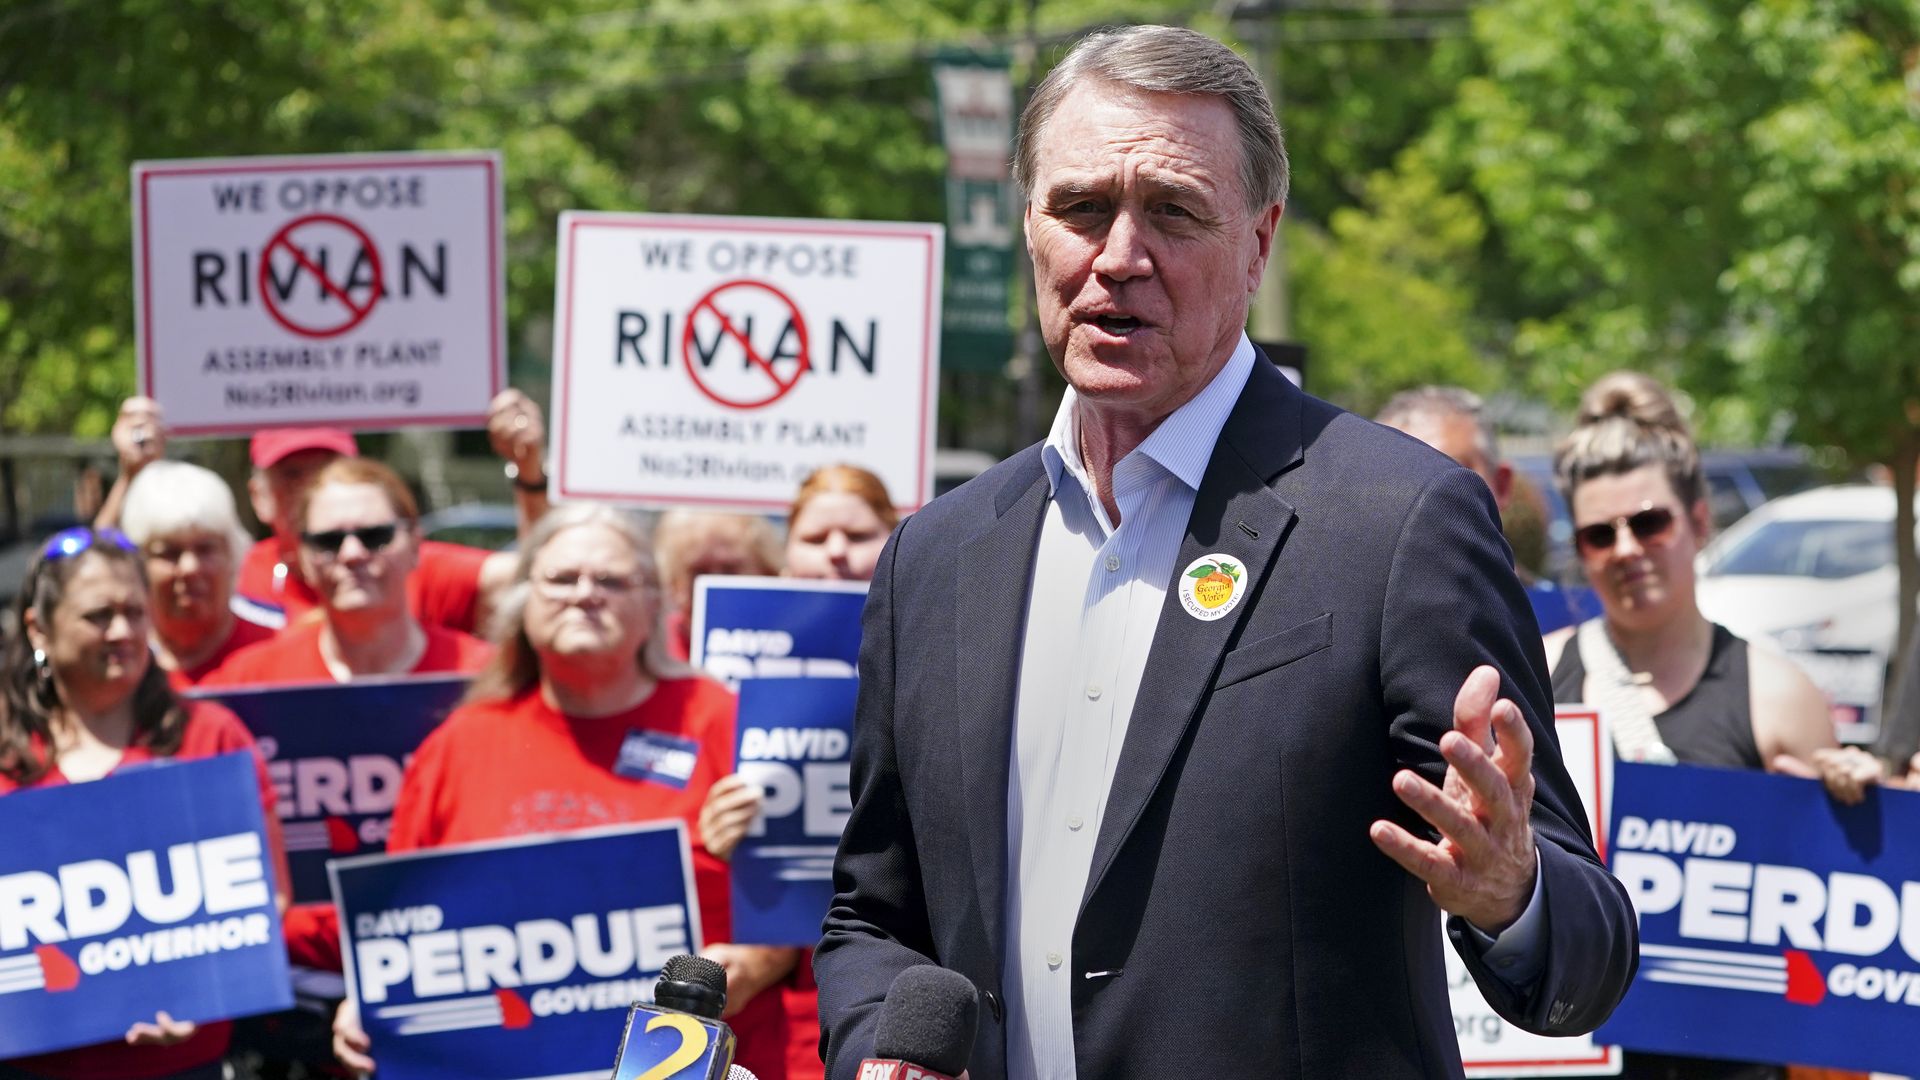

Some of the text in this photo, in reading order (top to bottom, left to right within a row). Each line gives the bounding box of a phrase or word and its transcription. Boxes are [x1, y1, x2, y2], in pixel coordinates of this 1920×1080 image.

[213, 176, 426, 213] WE OPPOSE
[192, 240, 449, 307] RIVIAN
[641, 240, 859, 278] WE OPPOSE
[203, 340, 443, 374] ASSEMBLY PLANT
[614, 311, 879, 376] RIVIAN
[619, 415, 867, 448] ASSEMBLY PLANT
[1197, 582, 1230, 596] Georgia
[1202, 593, 1225, 602] Voter
[706, 628, 794, 657] DAVID
[740, 727, 850, 760] DAVID
[1616, 815, 1737, 858] DAVID
[355, 904, 444, 938] DAVID
[1612, 849, 1920, 966] PERD
[78, 912, 270, 976] GOVERNOR
[355, 903, 693, 1004] PERDUE
[633, 1013, 708, 1080] 2
